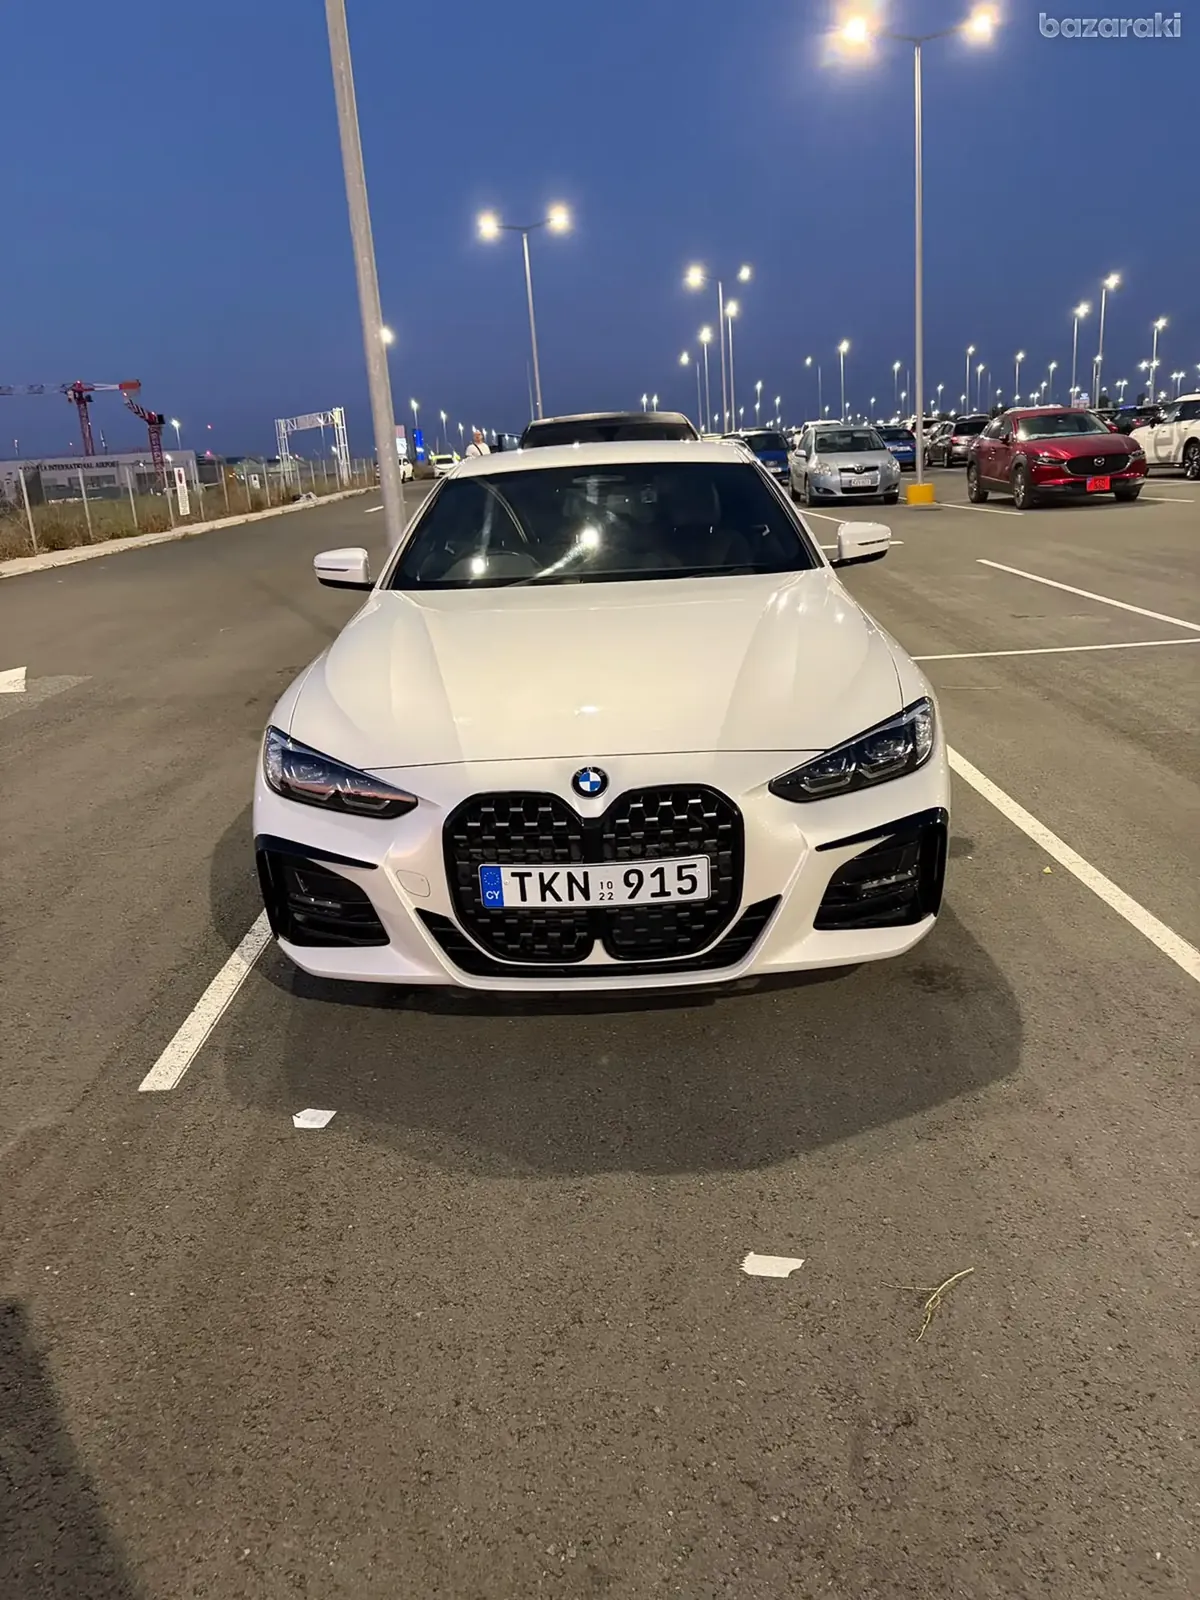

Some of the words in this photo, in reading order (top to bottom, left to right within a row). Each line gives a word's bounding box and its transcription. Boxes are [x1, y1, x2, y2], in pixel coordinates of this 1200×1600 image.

[510, 871, 591, 902] TKN
[623, 863, 698, 899] 915
[600, 881, 613, 889] 10
[486, 890, 500, 900] CY
[599, 892, 614, 900] 22
